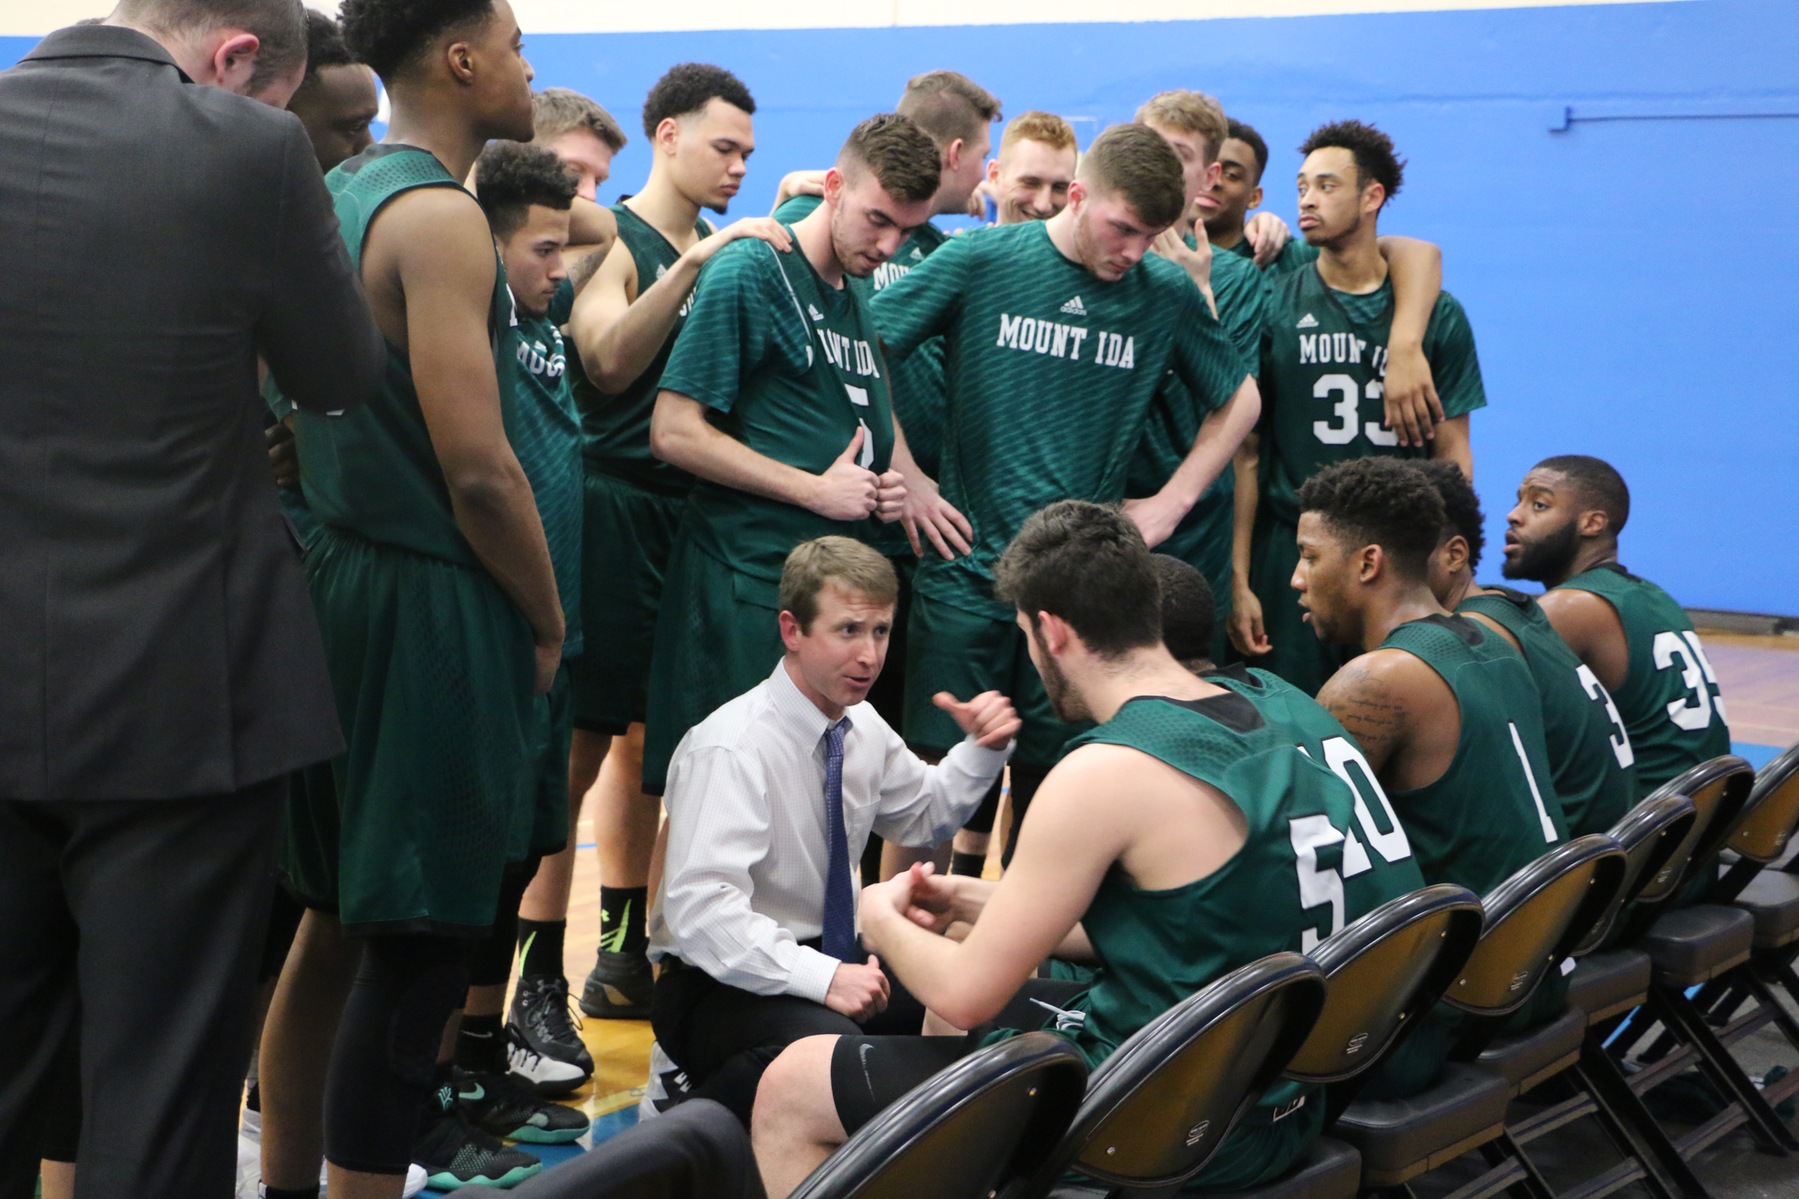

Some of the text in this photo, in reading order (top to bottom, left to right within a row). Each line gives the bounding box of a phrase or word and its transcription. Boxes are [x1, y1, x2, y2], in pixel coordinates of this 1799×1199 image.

[996, 313, 1134, 369] MOUNT IDA
[1576, 664, 1634, 769] 3
[1507, 722, 1558, 843] 1
[1289, 814, 1345, 955] 5
